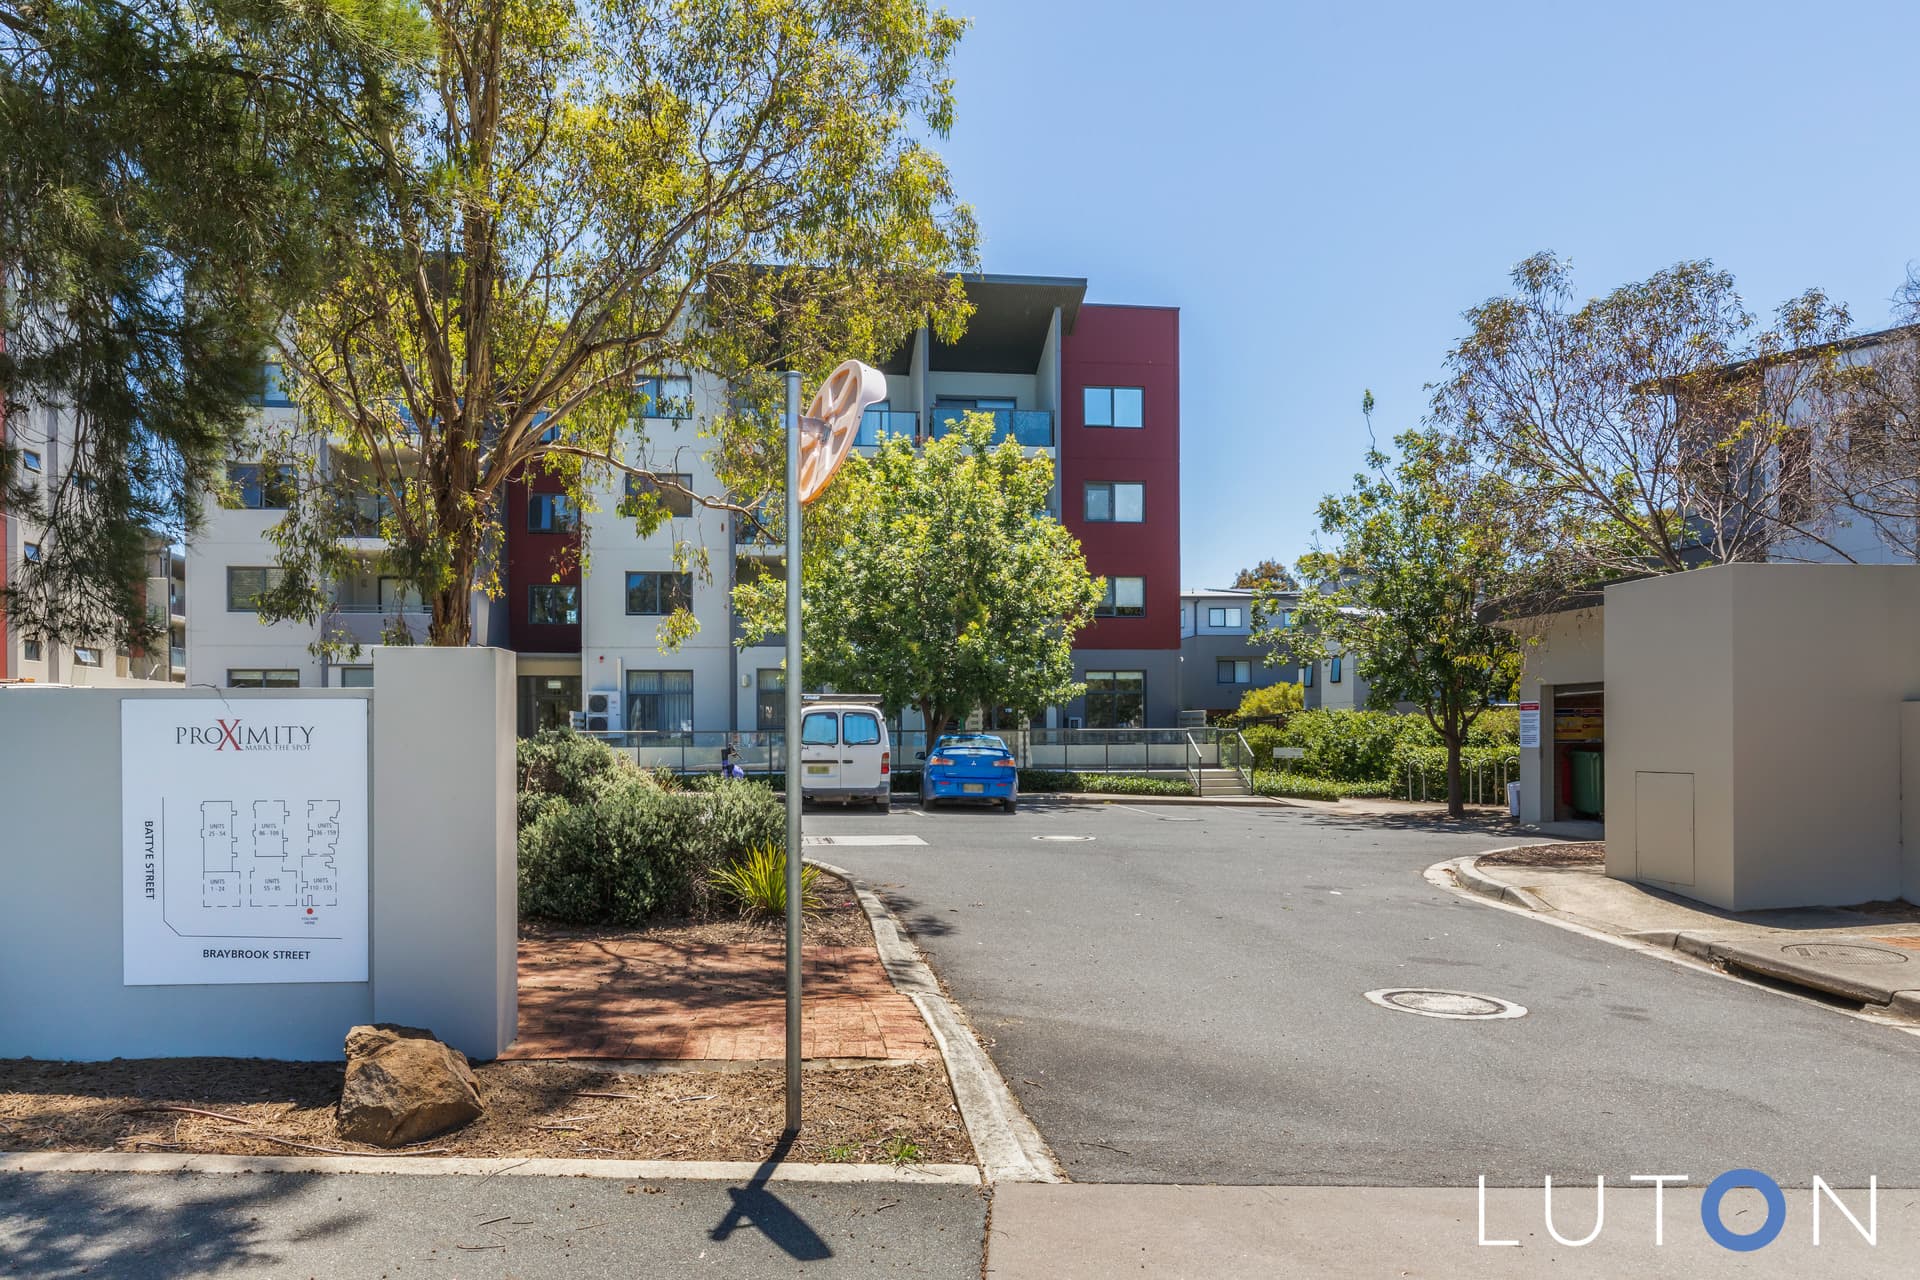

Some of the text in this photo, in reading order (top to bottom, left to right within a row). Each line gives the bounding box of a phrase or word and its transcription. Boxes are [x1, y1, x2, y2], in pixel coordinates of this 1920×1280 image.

[175, 719, 315, 751] PROXIMITY
[144, 820, 155, 900] BATTYE STREET
[202, 949, 311, 960] BRAYBROOK STREET
